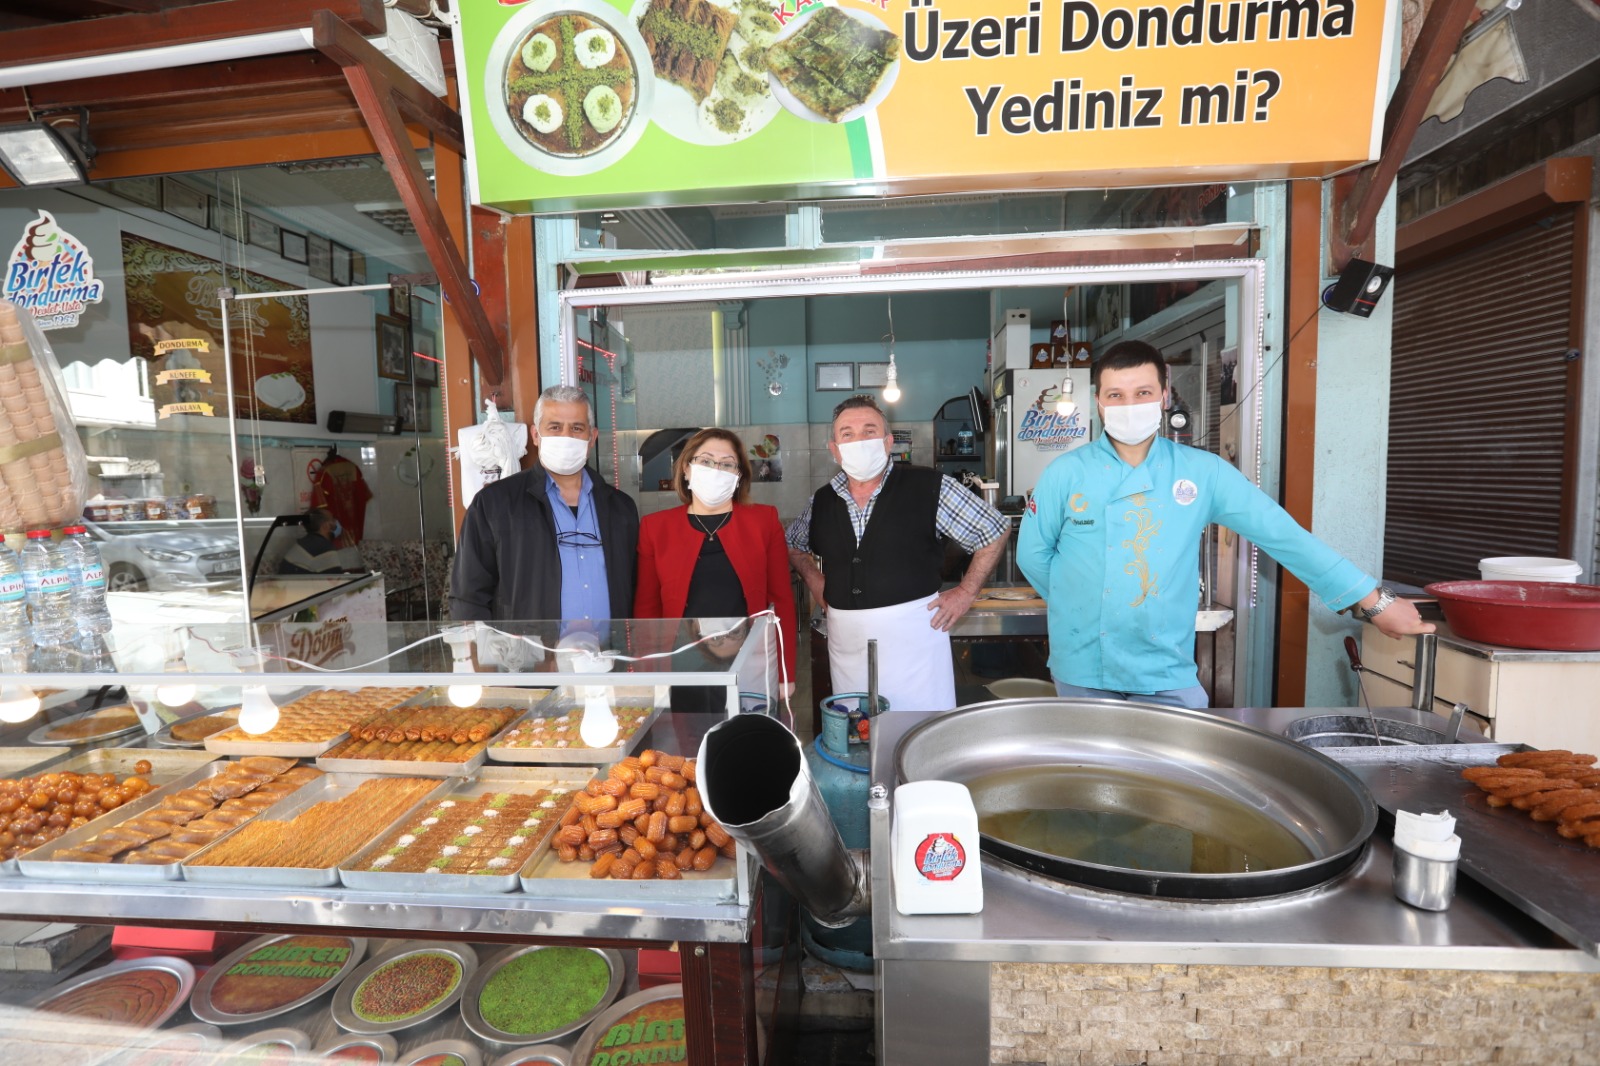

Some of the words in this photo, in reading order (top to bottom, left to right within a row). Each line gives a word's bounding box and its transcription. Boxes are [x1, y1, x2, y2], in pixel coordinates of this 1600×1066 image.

[904, 0, 1042, 61] Üzeri
[1060, 0, 1354, 53] Dondurma
[965, 77, 1163, 135] Yediniz
[1181, 69, 1281, 125] mi?
[7, 251, 88, 292] Birtek
[159, 340, 203, 349] DONDURMA
[170, 404, 202, 412] BAKLAVA
[1017, 426, 1086, 440] dondurma
